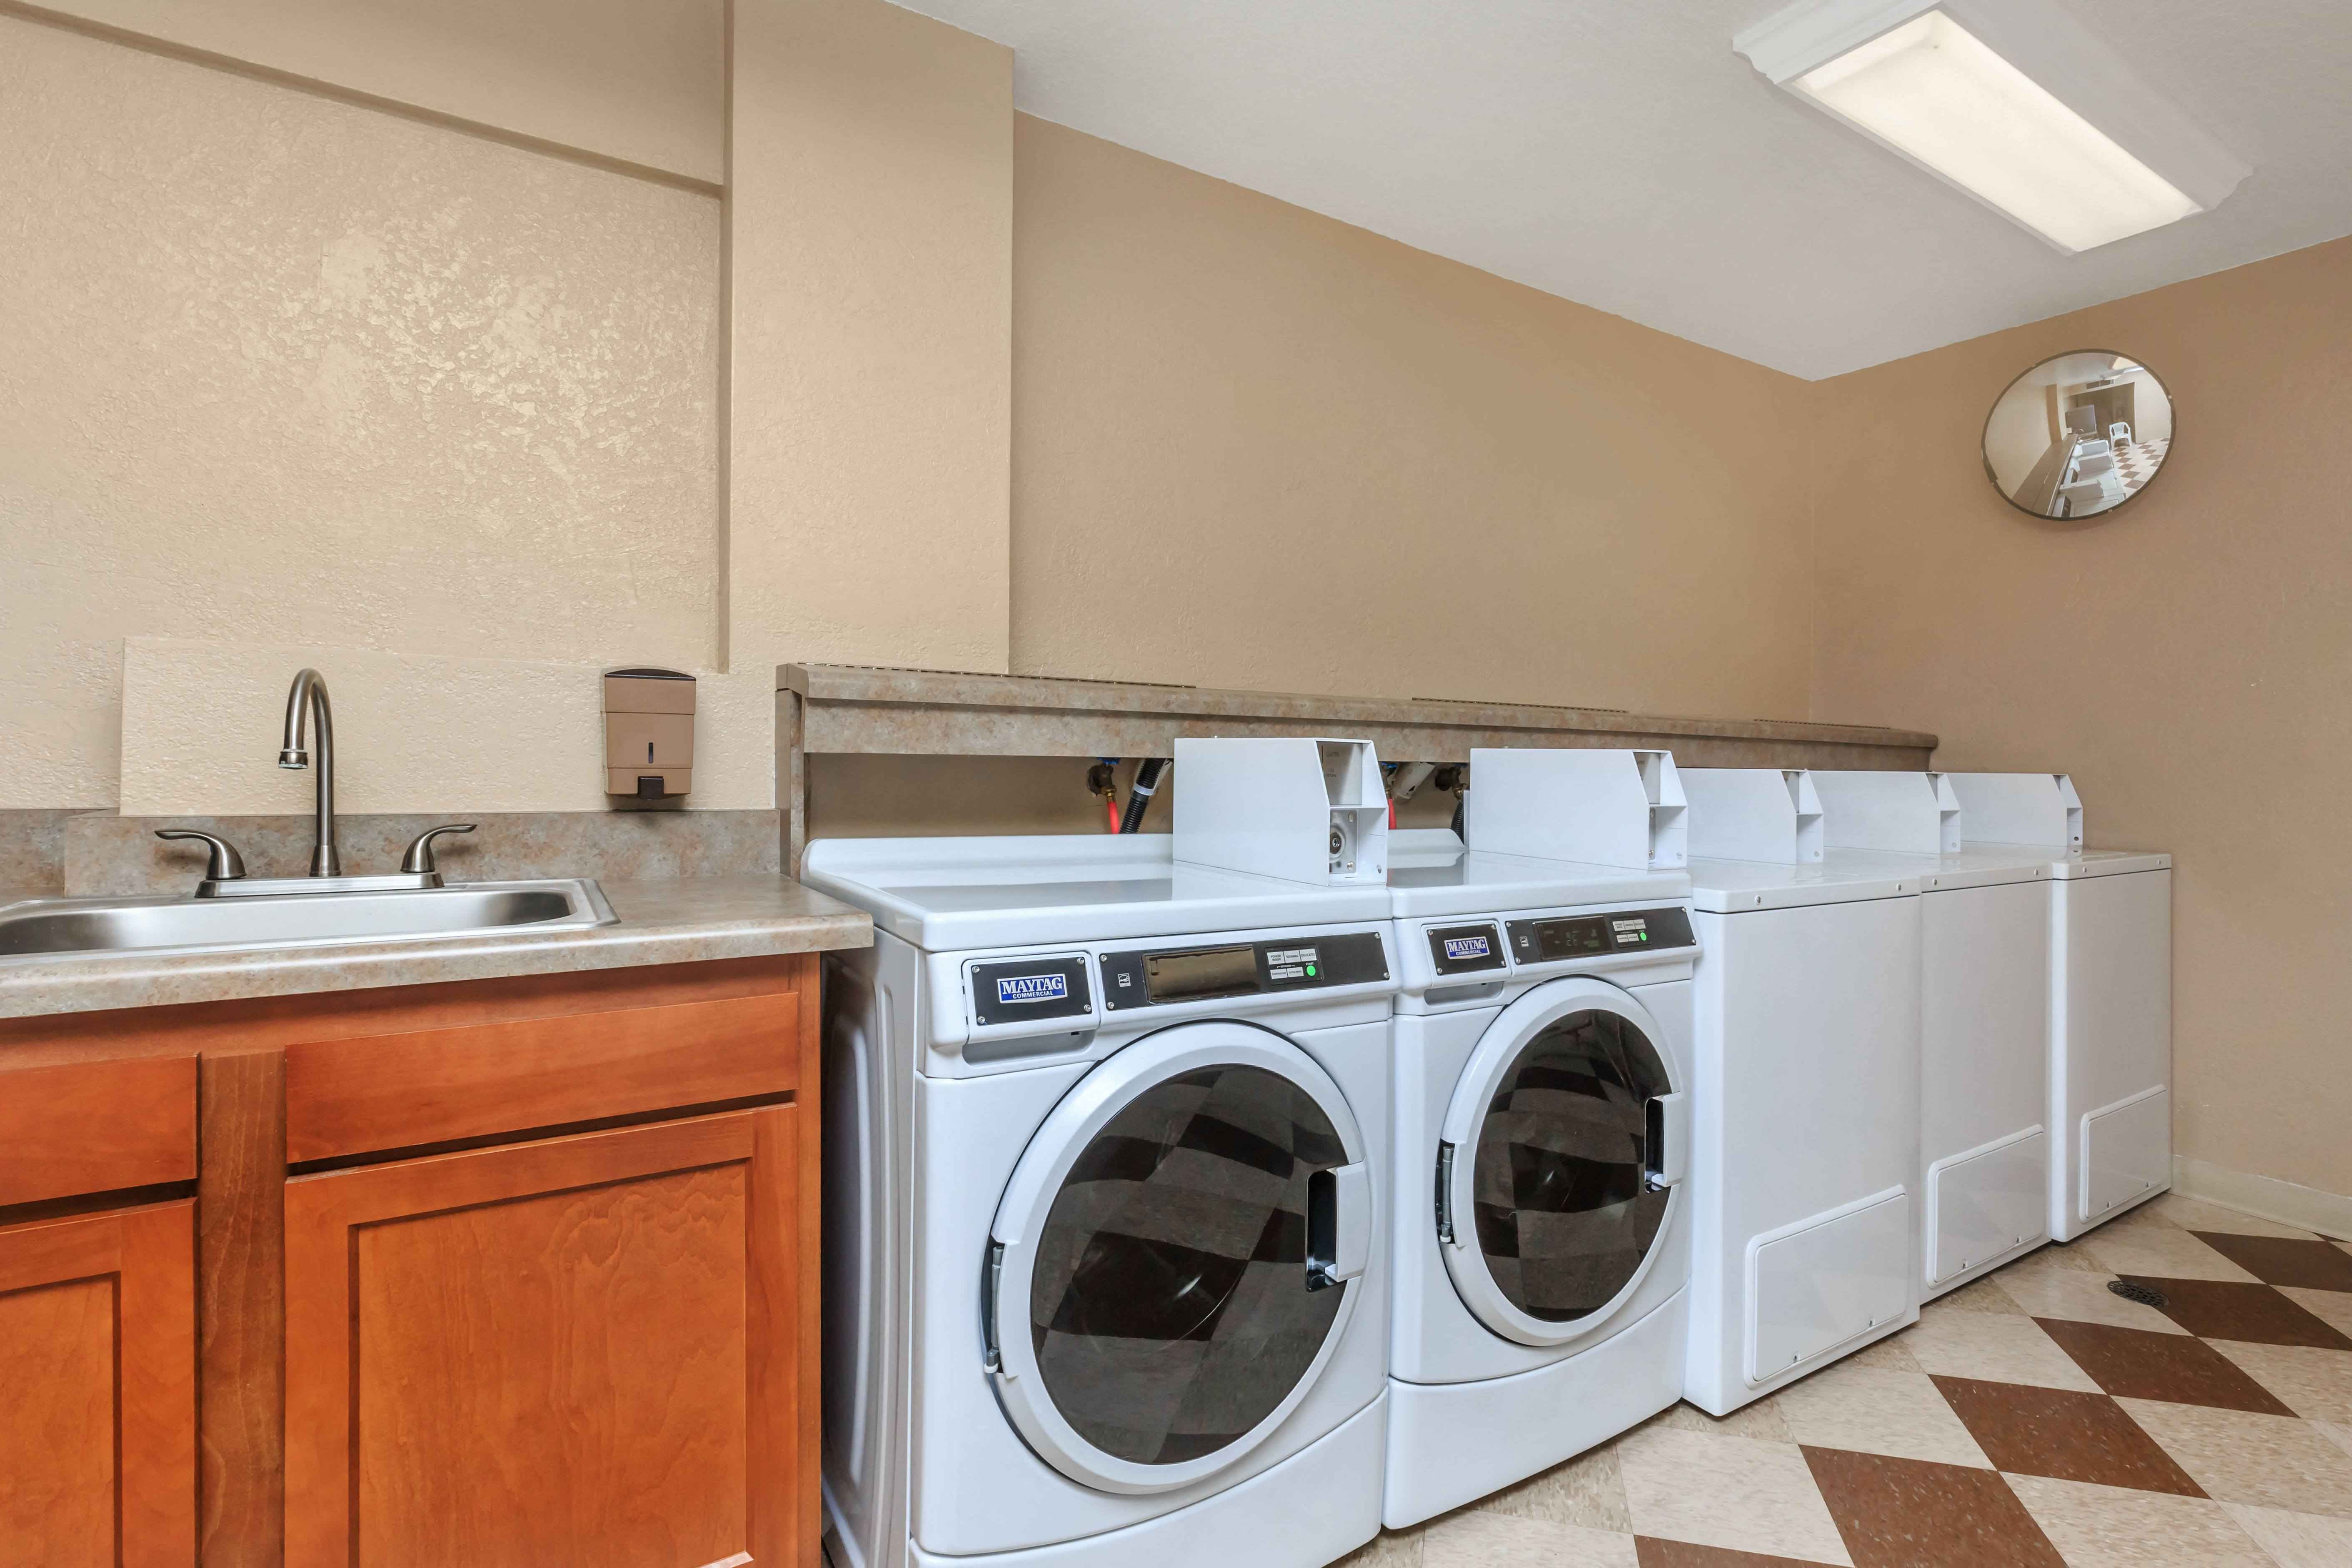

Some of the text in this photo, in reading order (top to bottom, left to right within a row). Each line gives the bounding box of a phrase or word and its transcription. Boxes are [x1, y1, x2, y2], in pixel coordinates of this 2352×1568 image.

[1447, 939, 1486, 952] MAYTAG
[1001, 977, 1063, 994] MAYTAG
[1013, 991, 1054, 999] COMMERCIAL
